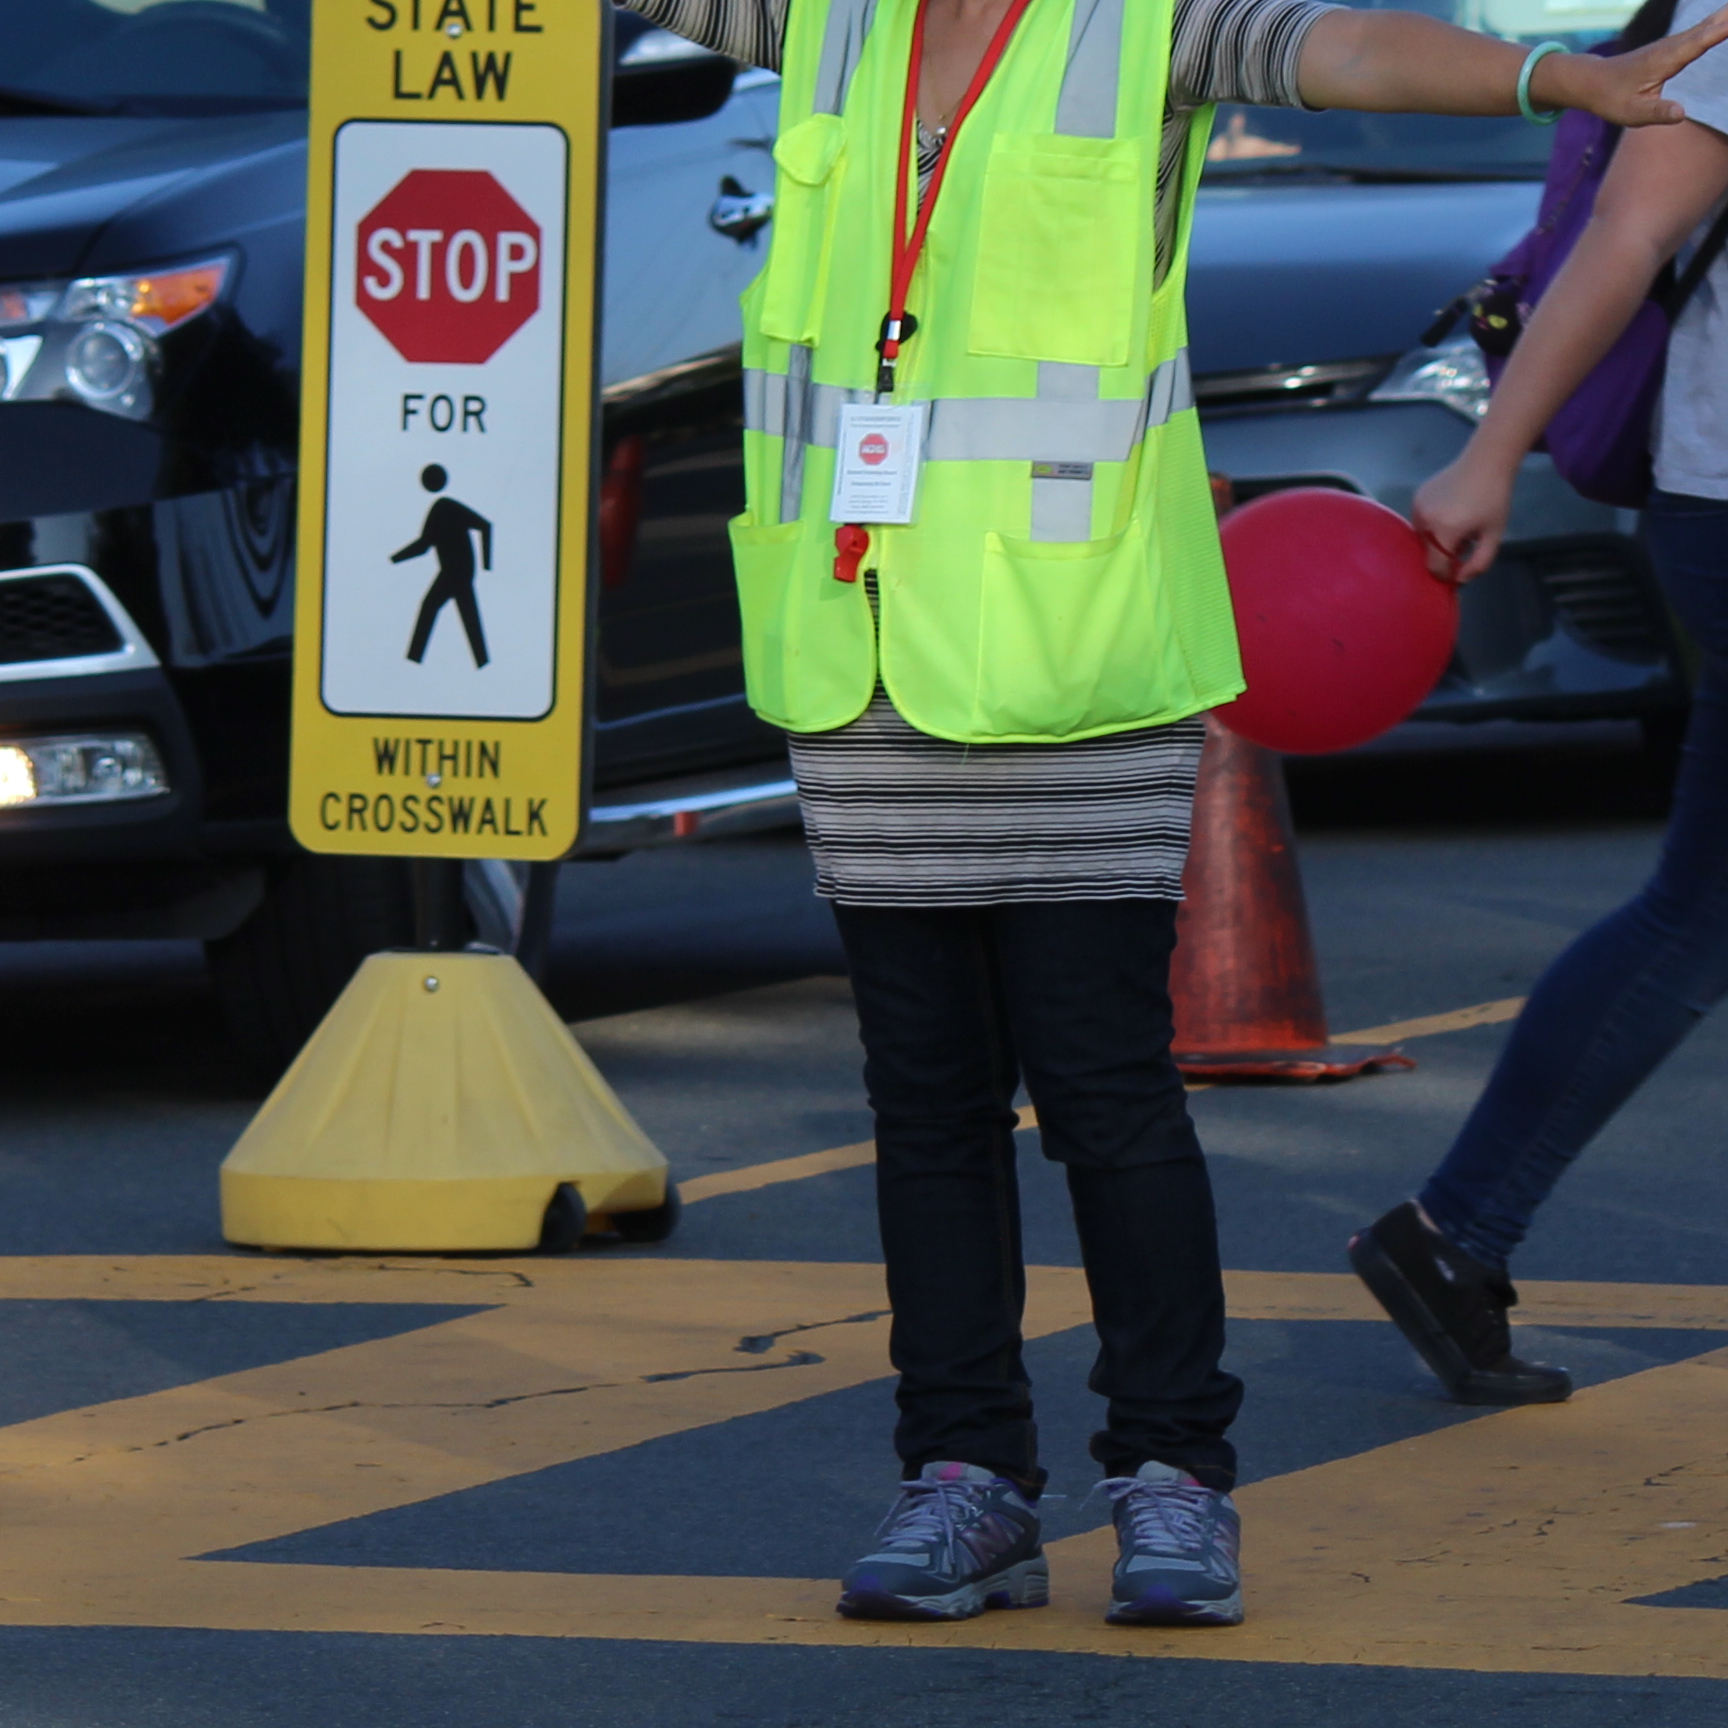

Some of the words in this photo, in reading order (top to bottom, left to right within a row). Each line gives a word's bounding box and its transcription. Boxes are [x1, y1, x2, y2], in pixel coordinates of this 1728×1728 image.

[393, 49, 512, 102] LAW
[363, 227, 539, 303] STOP
[402, 393, 487, 433] FOR
[373, 736, 501, 778] WITHIN
[320, 792, 549, 837] CROSSWALK
